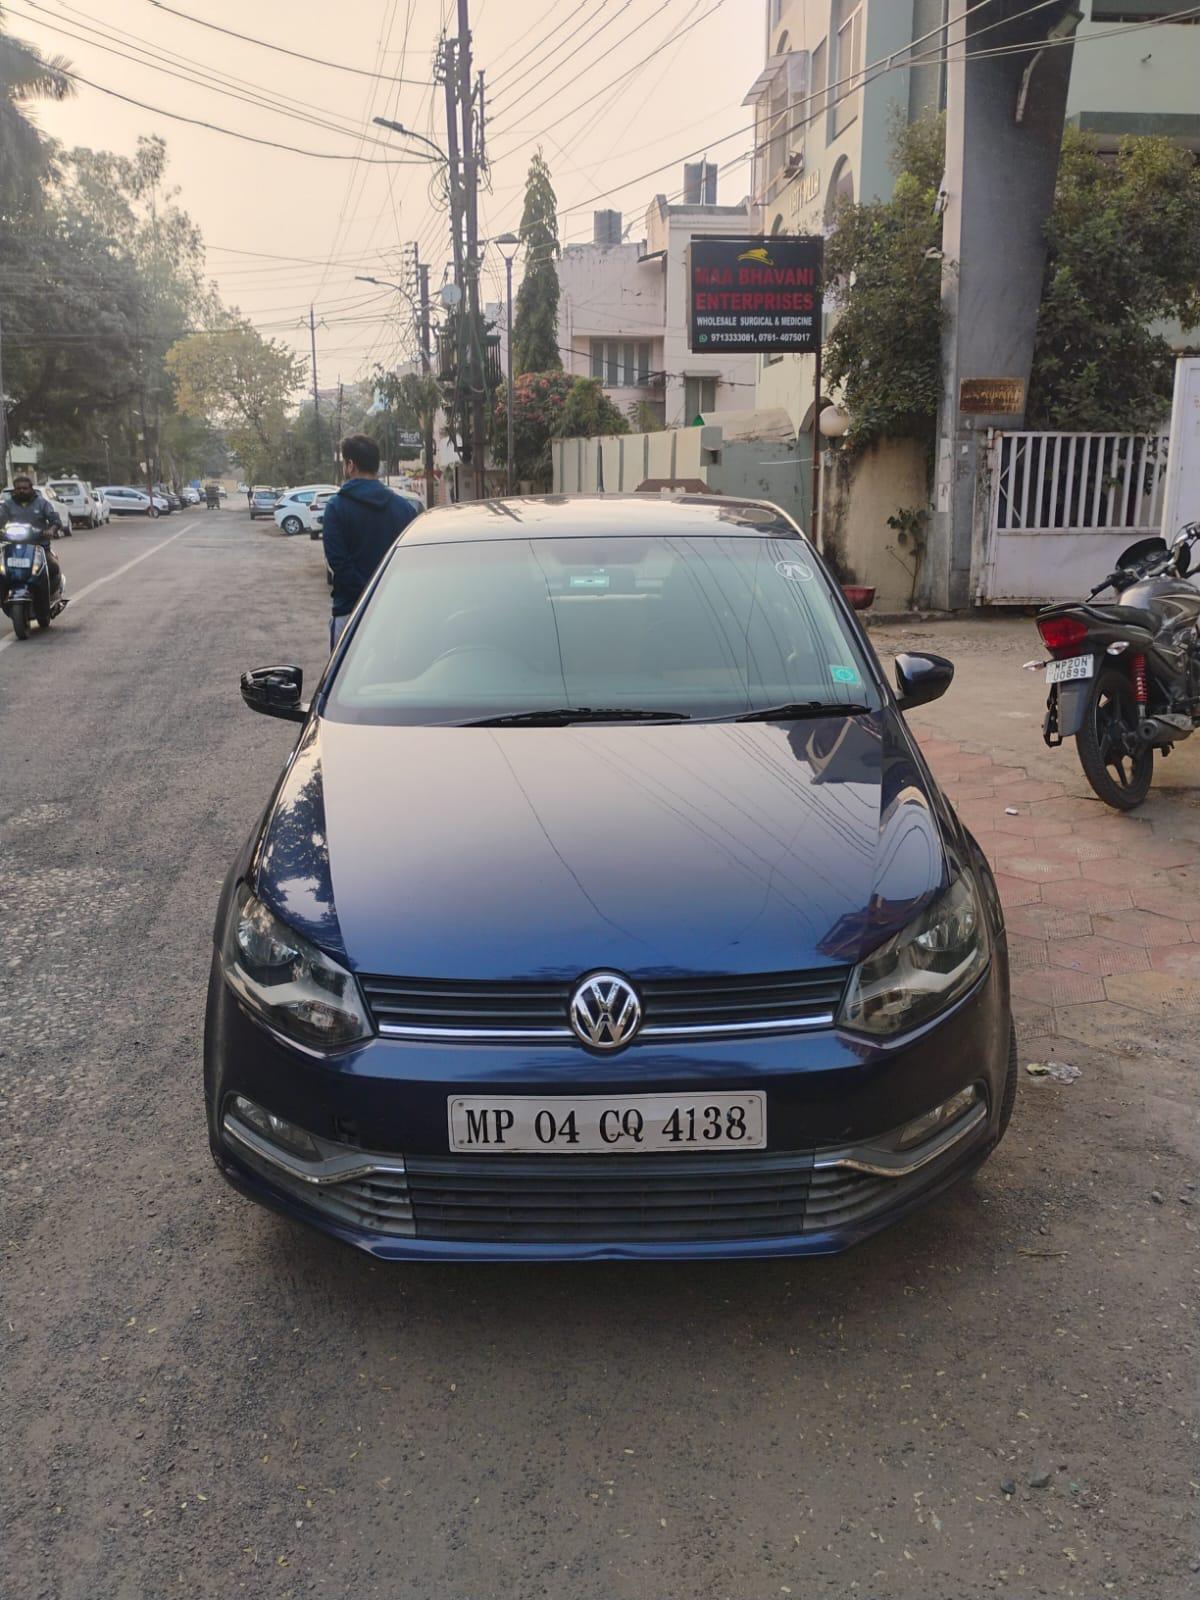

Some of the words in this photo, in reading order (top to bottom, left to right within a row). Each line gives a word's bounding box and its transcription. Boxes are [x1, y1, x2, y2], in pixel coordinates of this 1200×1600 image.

[696, 267, 732, 285] MAA
[739, 268, 815, 286] BHAVANI
[696, 293, 814, 310] ENTERPRISES
[697, 316, 737, 326] WHOLESALE
[740, 316, 773, 326] SURGICAL
[774, 317, 780, 326] &
[781, 316, 812, 326] MEDICINE
[465, 1109, 514, 1144] MP
[535, 1109, 580, 1144] 04
[600, 1108, 644, 1144] CQ
[662, 1105, 747, 1142] 4138
